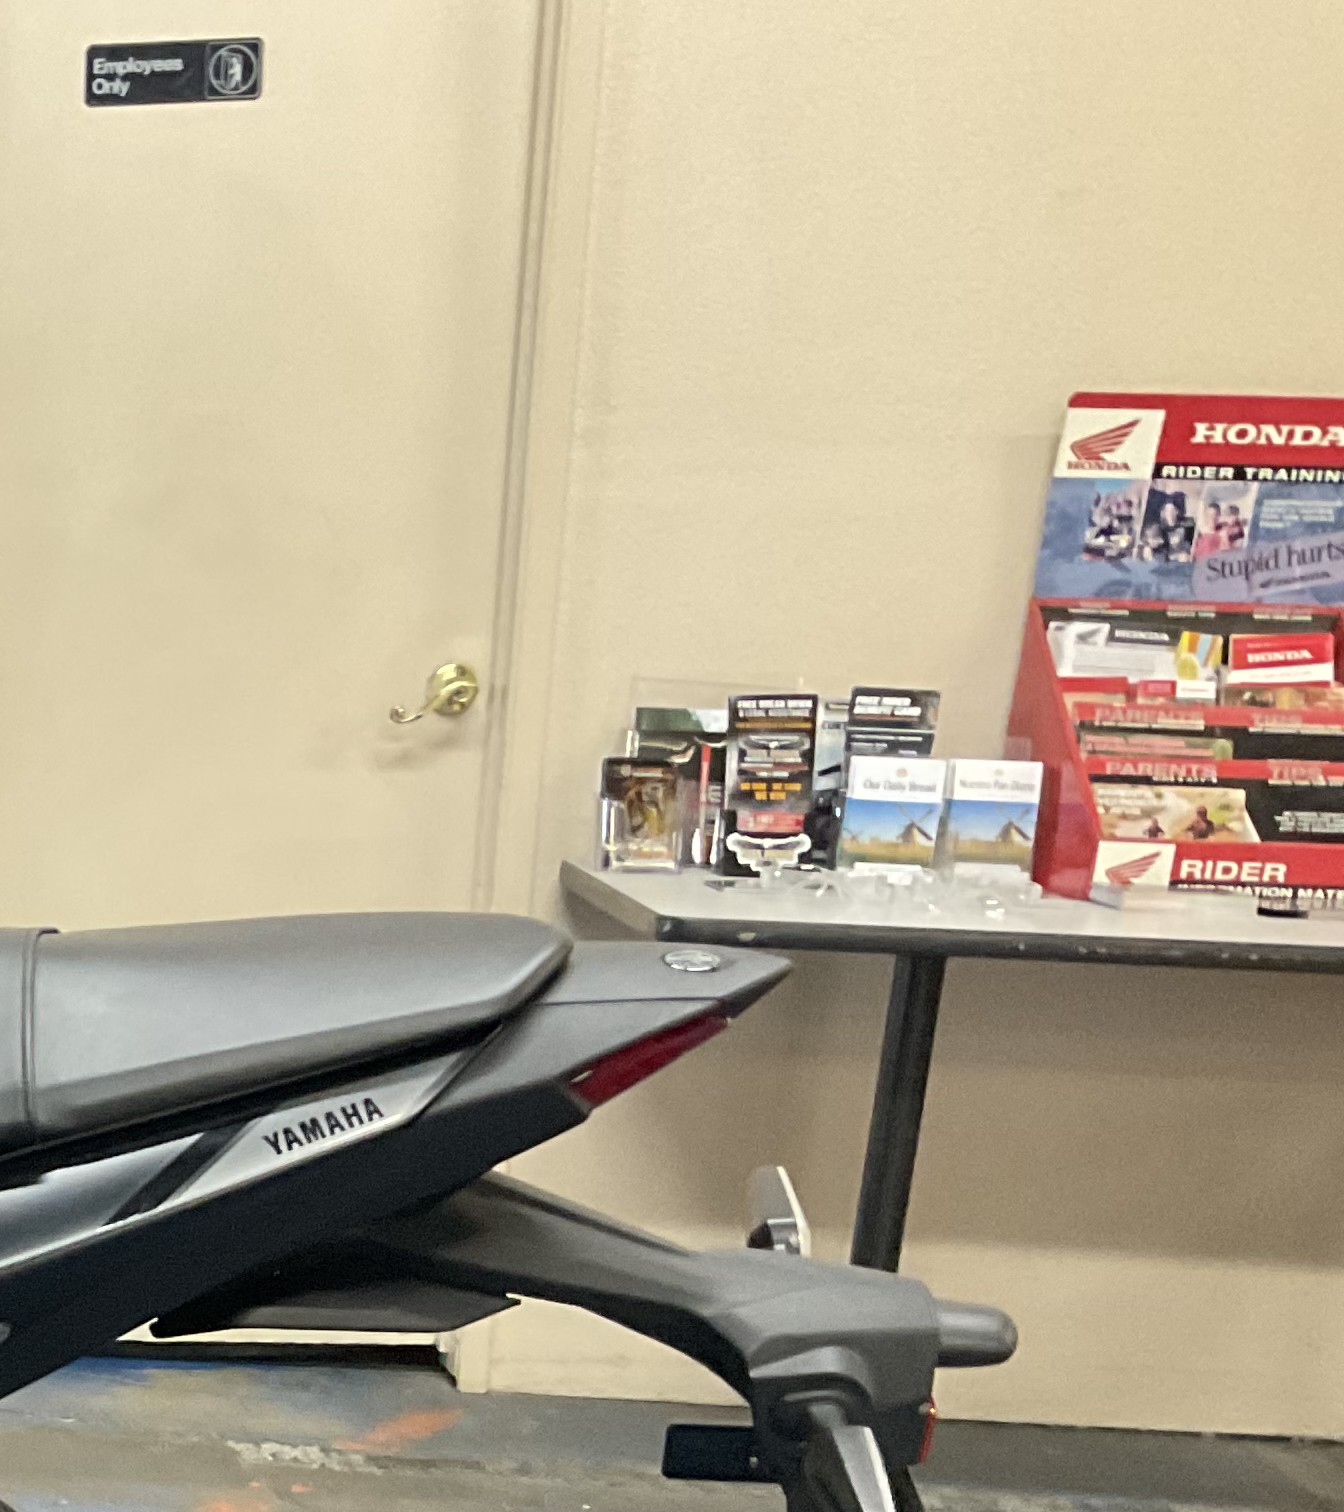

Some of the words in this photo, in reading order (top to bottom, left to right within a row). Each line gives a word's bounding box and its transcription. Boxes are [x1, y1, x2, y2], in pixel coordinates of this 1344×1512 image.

[93, 57, 184, 76] Employees
[92, 78, 131, 97] Only
[1190, 422, 1344, 447] HONDA
[1067, 459, 1131, 471] HONDA
[1161, 465, 1235, 480] RIDER
[1245, 467, 1344, 483] TRAININ
[1206, 547, 1280, 588] Stupid
[1246, 650, 1313, 664] HONDA
[1105, 760, 1218, 778] PARENTS
[1179, 859, 1288, 883] RIDER
[262, 1098, 385, 1155] YAMAHA
